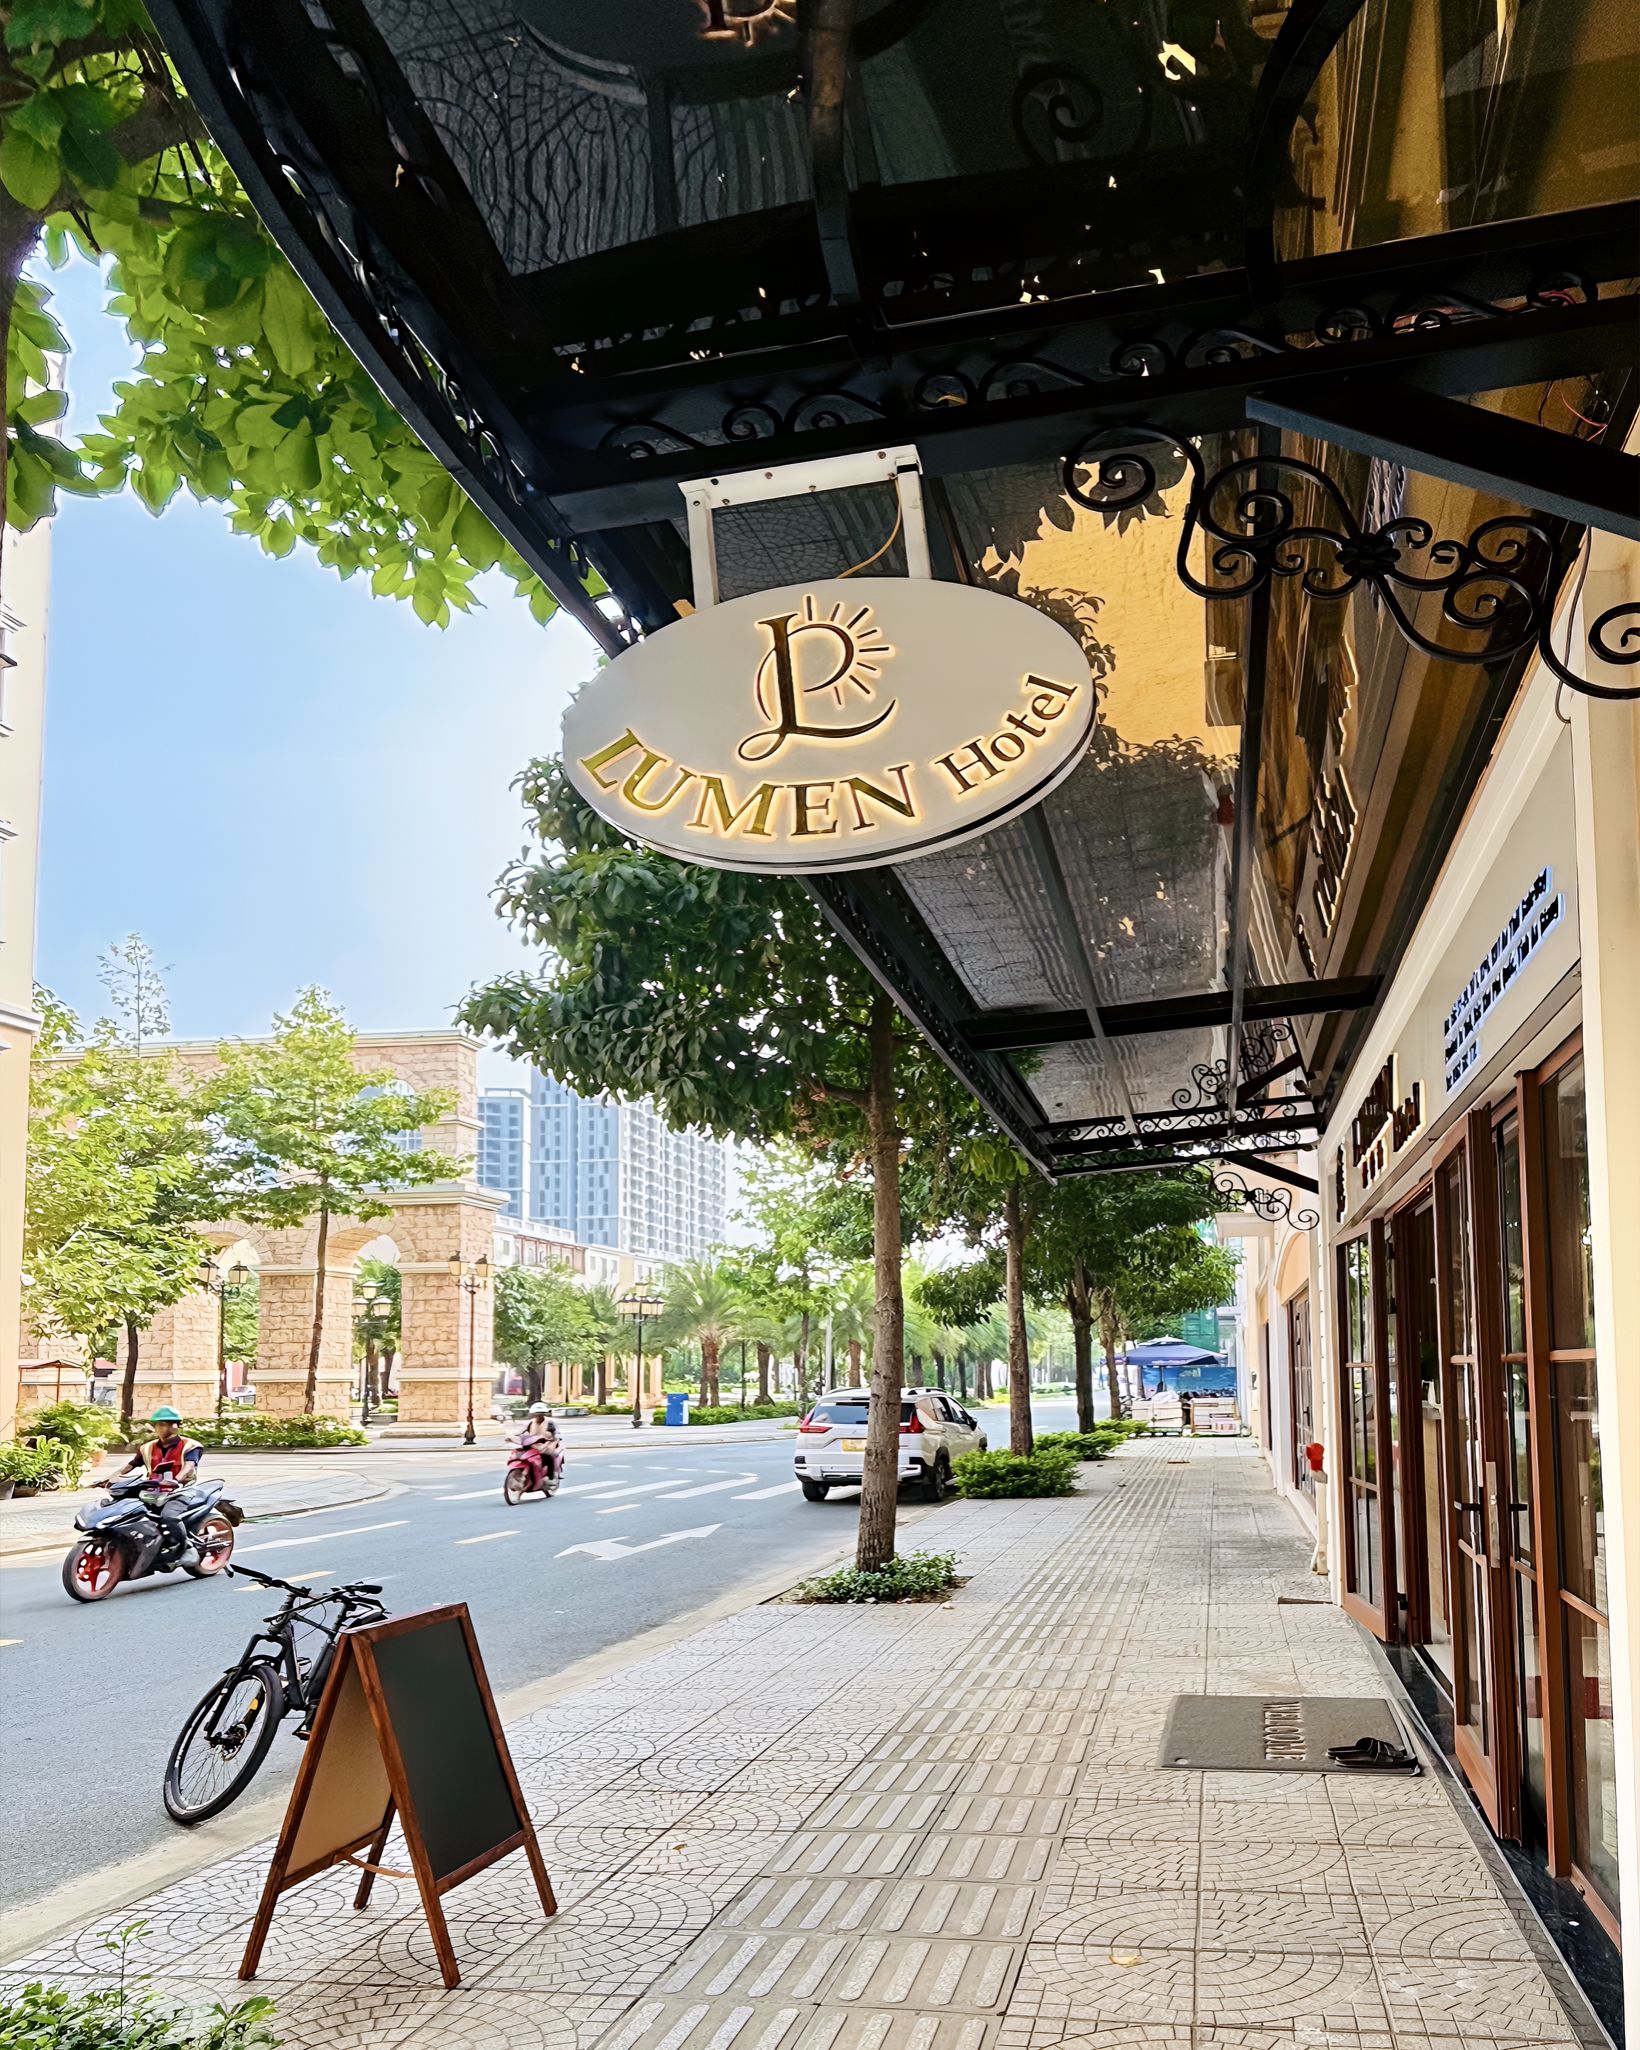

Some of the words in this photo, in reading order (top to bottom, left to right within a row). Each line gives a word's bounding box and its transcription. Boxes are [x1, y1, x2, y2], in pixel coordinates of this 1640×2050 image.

[580, 727, 914, 837] LUMEN
[934, 672, 1079, 796] Hotel
[1263, 1701, 1307, 1761] WELCOME
